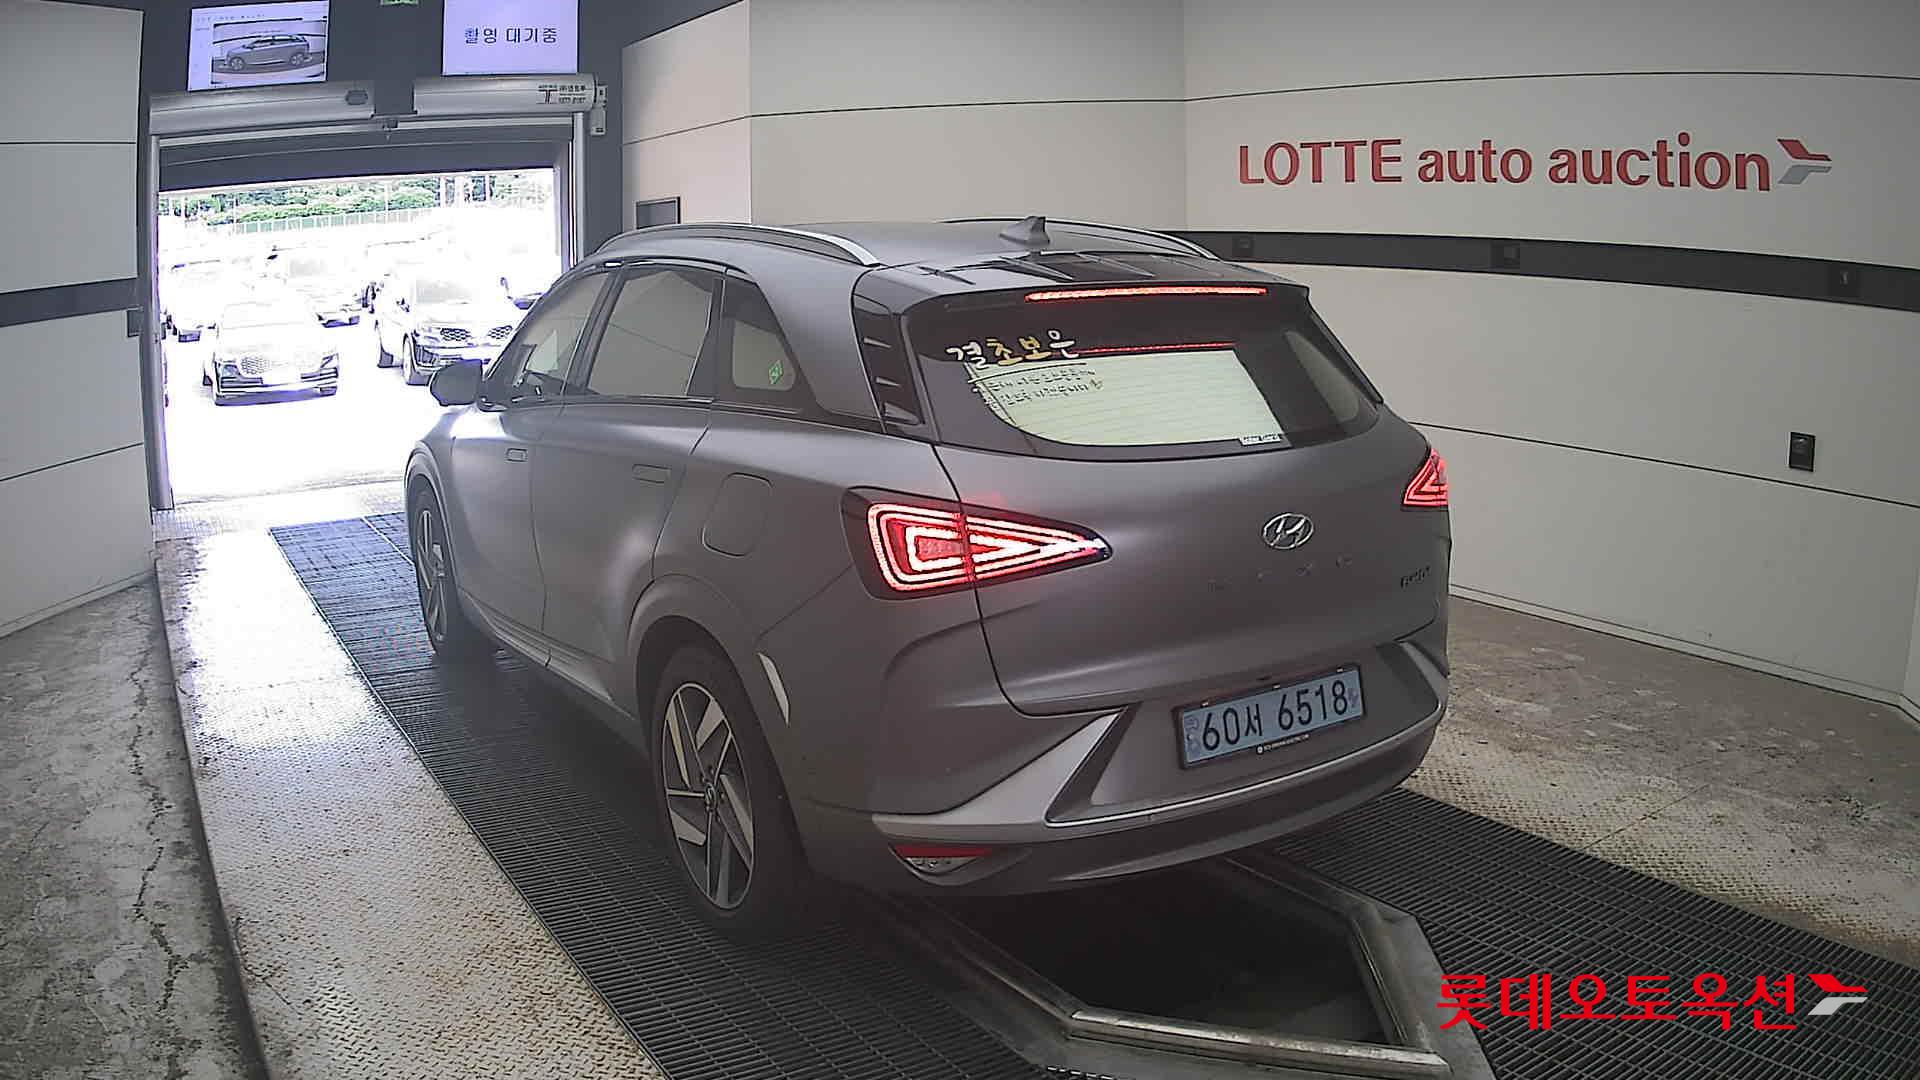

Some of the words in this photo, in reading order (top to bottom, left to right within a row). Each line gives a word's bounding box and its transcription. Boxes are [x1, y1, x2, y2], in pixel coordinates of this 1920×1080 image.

[506, 27, 558, 44] 대기중
[1239, 138, 1402, 186] LOTTE
[1417, 139, 1533, 185] auto
[1548, 131, 1771, 191] auction
[946, 329, 1079, 371] 결초보은
[1202, 703, 1264, 752] 60서
[1278, 680, 1349, 732] 6518
